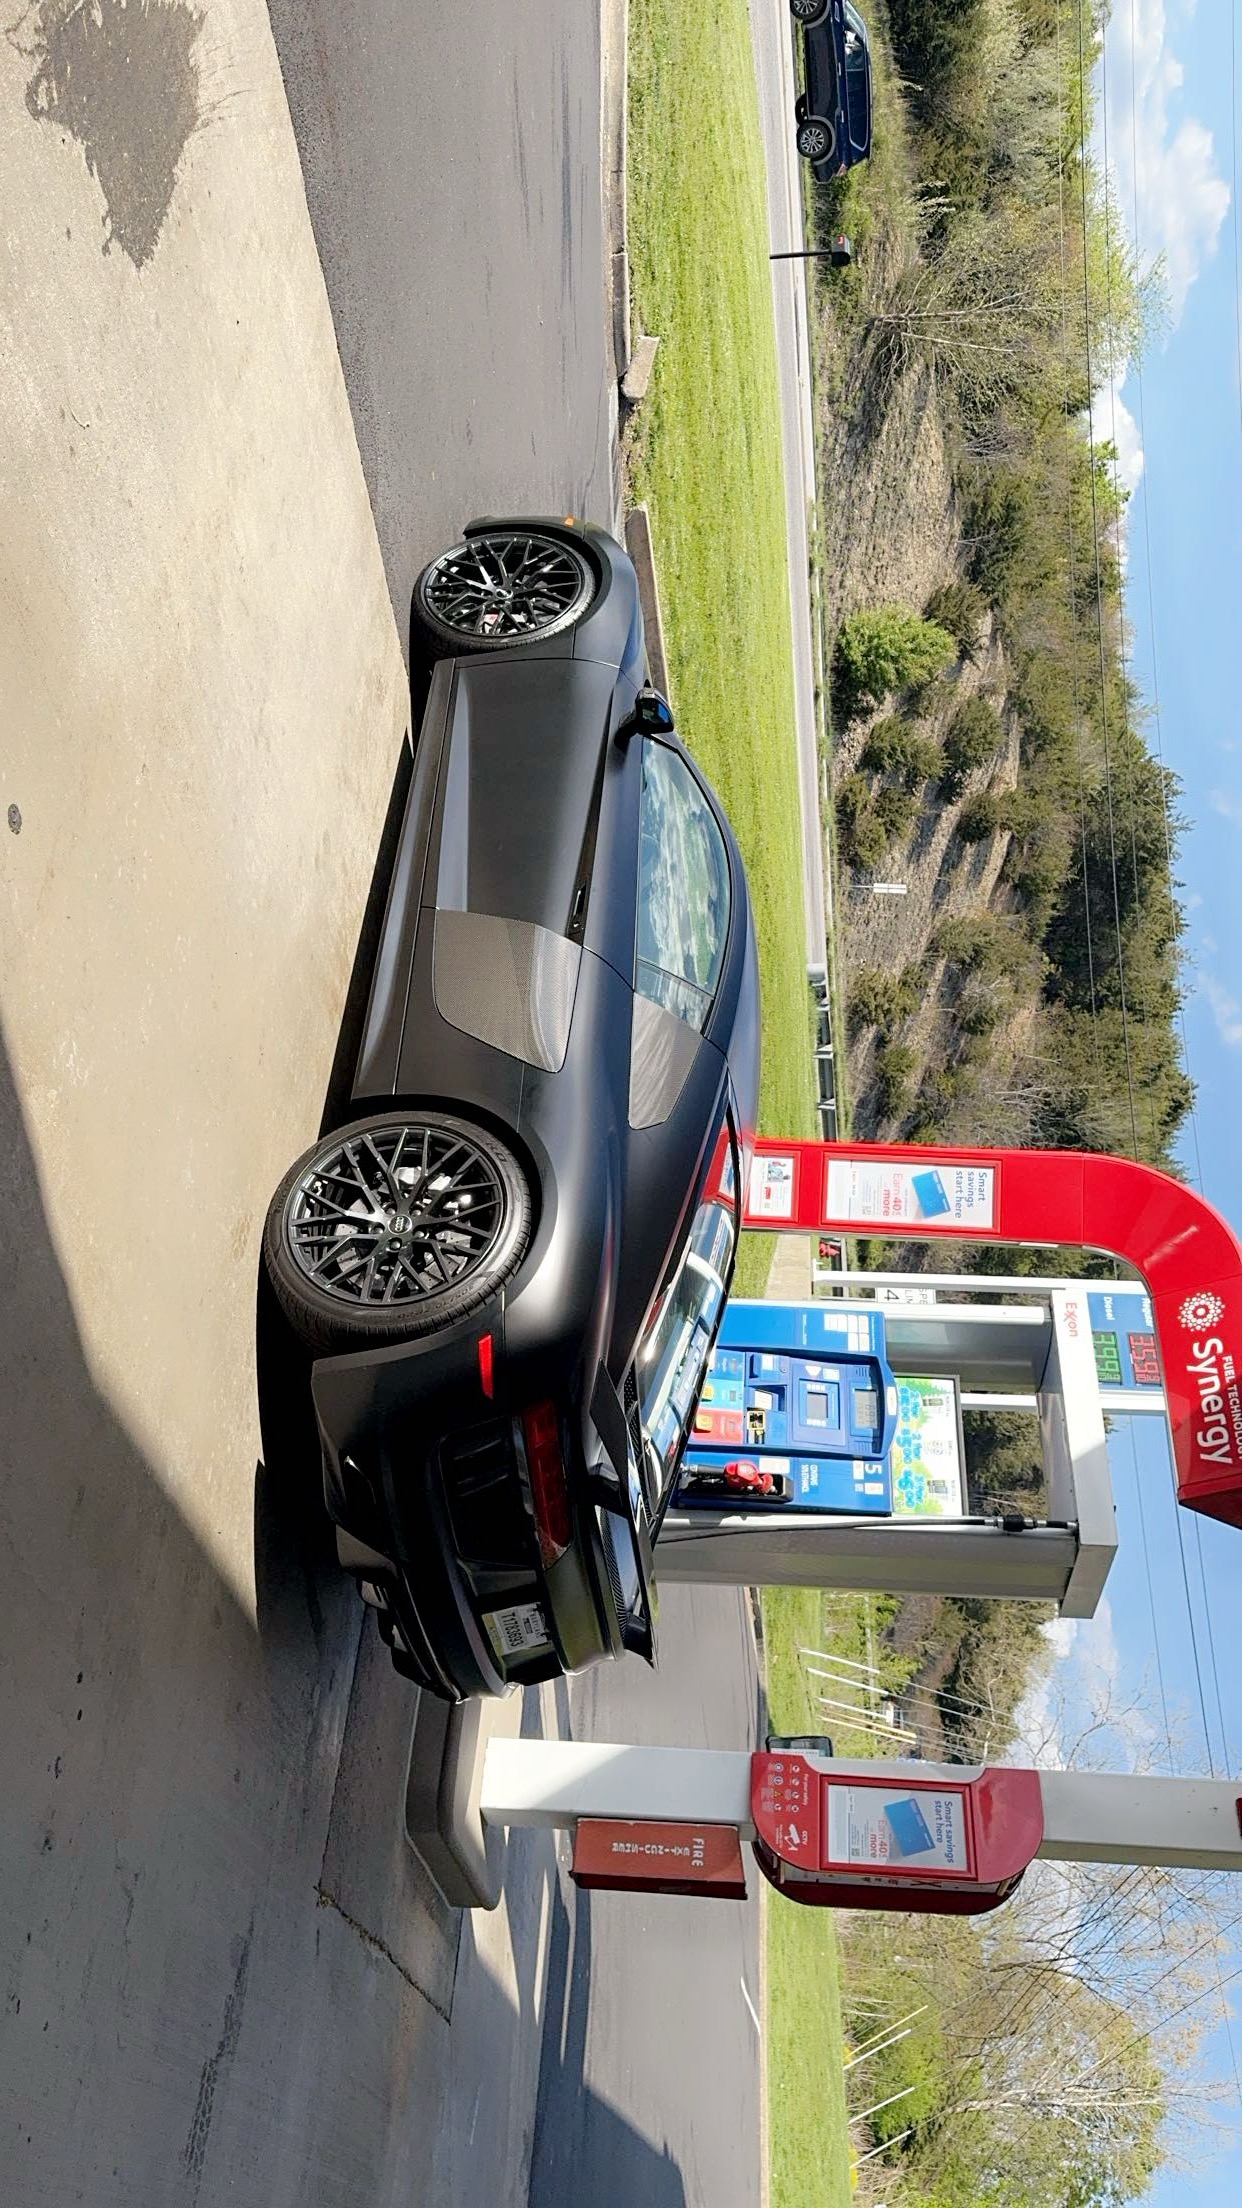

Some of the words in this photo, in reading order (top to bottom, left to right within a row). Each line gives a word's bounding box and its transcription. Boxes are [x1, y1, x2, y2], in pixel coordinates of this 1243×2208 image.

[892, 1173, 902, 1195] Earn
[955, 1170, 964, 1194] start
[964, 1171, 976, 1208] savings
[978, 1172, 988, 1201] Smart
[882, 1189, 890, 1216] more
[954, 1196, 964, 1218] here
[1064, 1302, 1078, 1337] Exxon
[1104, 1296, 1115, 1320] Diesel
[1222, 1356, 1234, 1383] FUEL
[1186, 1338, 1232, 1464] Synergy
[810, 1464, 818, 1486] CONTAINS
[864, 1464, 882, 1474] 5
[802, 1472, 810, 1494] ETHANOL
[934, 1800, 942, 1820] start
[944, 1801, 953, 1828] Smart
[878, 1820, 886, 1840] Earn
[936, 1822, 944, 1843] here
[692, 1838, 704, 1867] FIRE
[870, 1834, 878, 1858] more
[944, 1830, 956, 1864] savings
